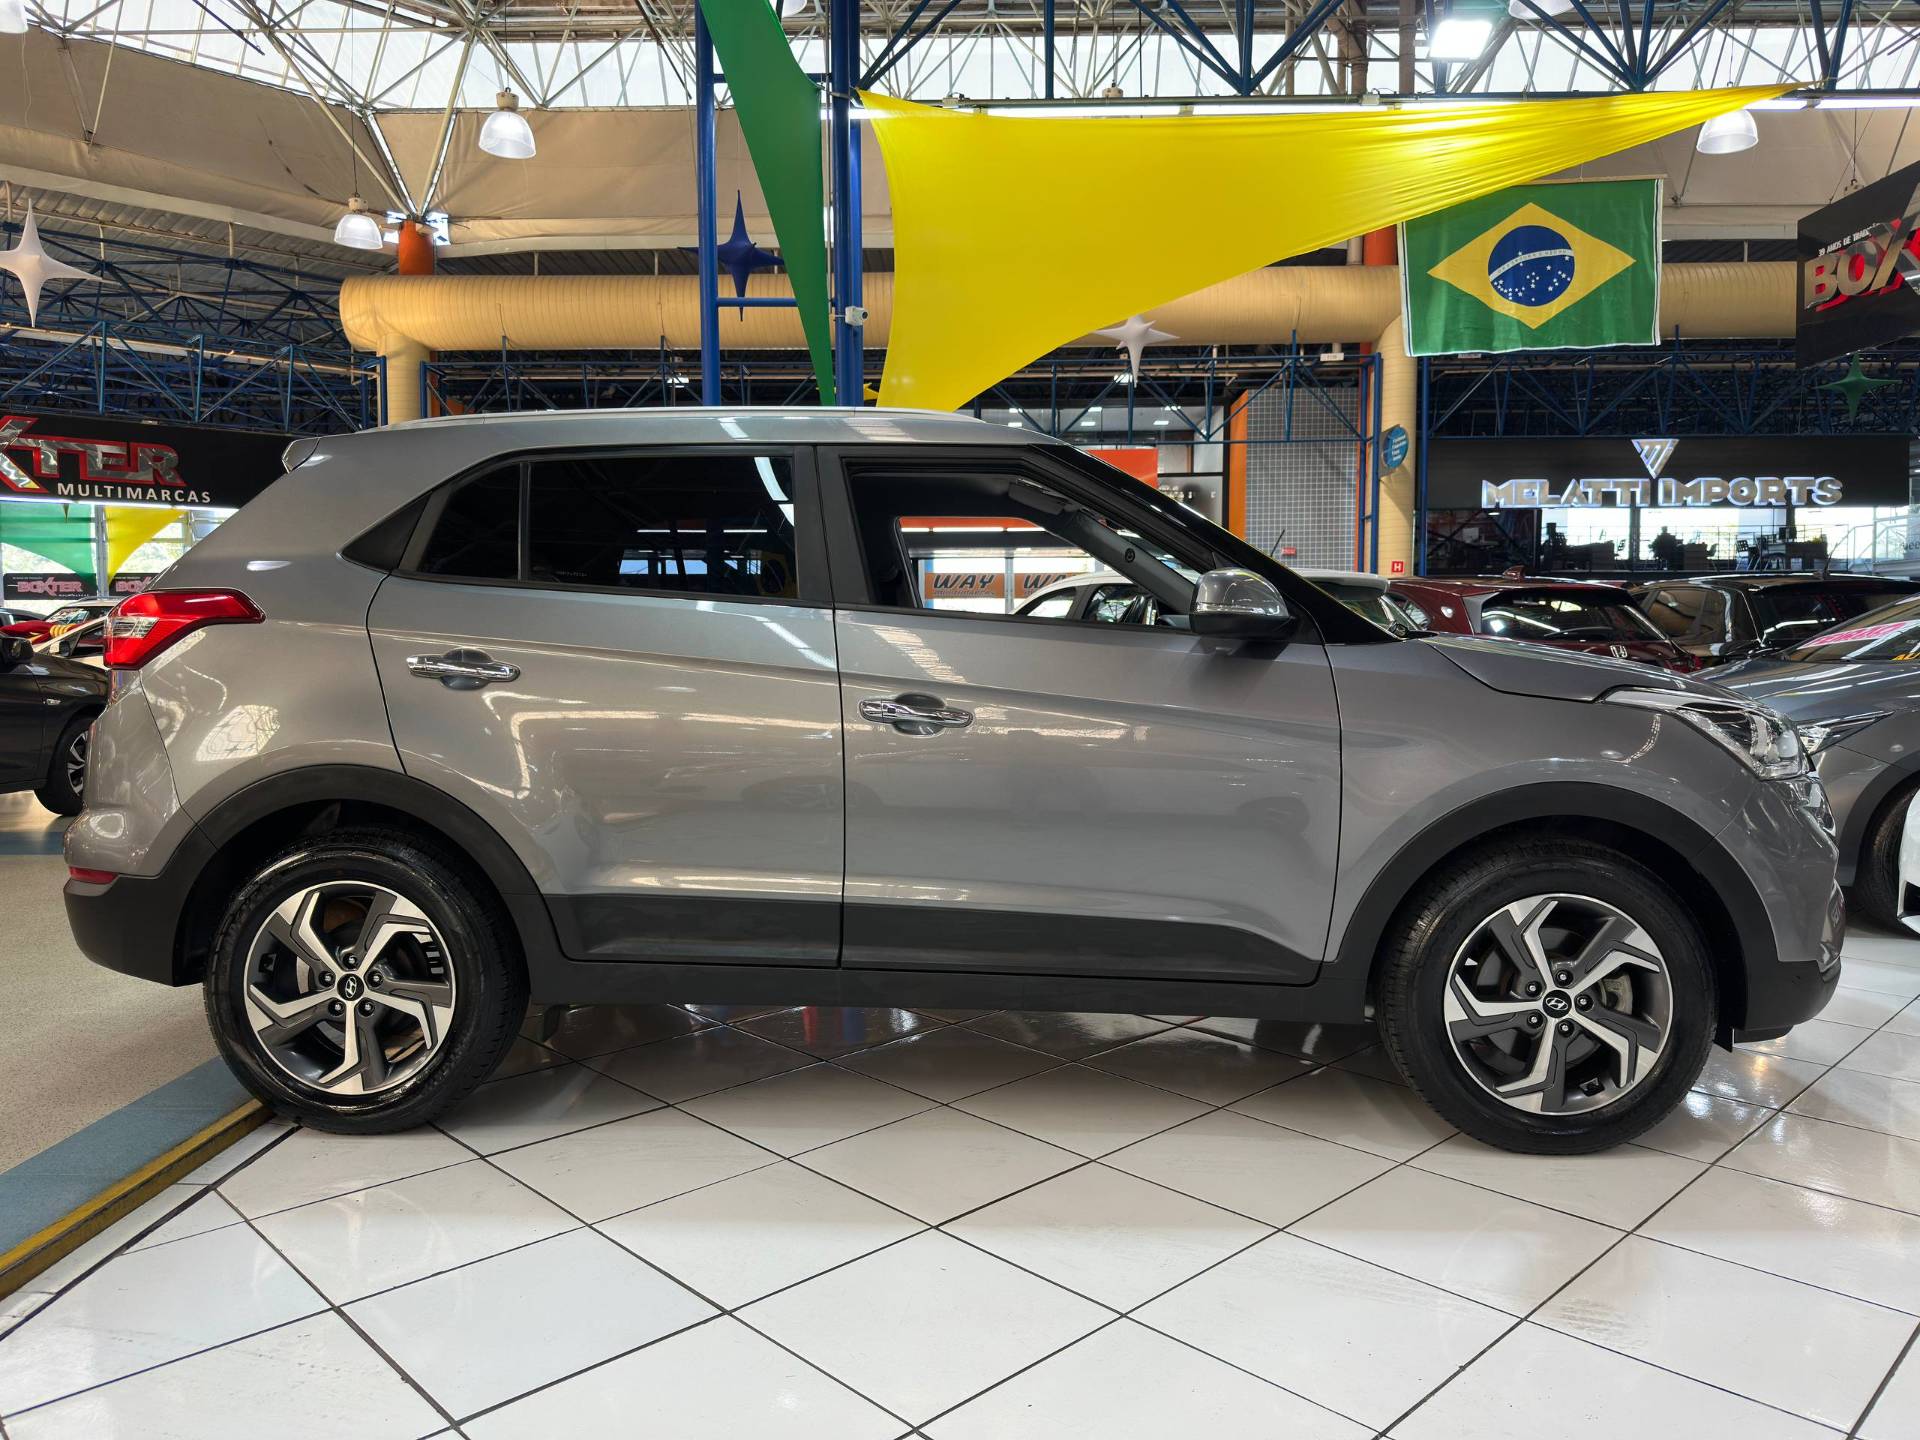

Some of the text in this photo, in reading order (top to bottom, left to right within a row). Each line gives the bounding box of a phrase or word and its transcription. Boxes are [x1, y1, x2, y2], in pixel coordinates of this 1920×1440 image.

[1843, 235, 1852, 245] DE
[57, 483, 212, 504] MULTIMARCAS
[1481, 476, 1844, 509] MELATTI IMPORTS
[17, 577, 84, 597] BOXTER
[933, 574, 995, 589] WAY
